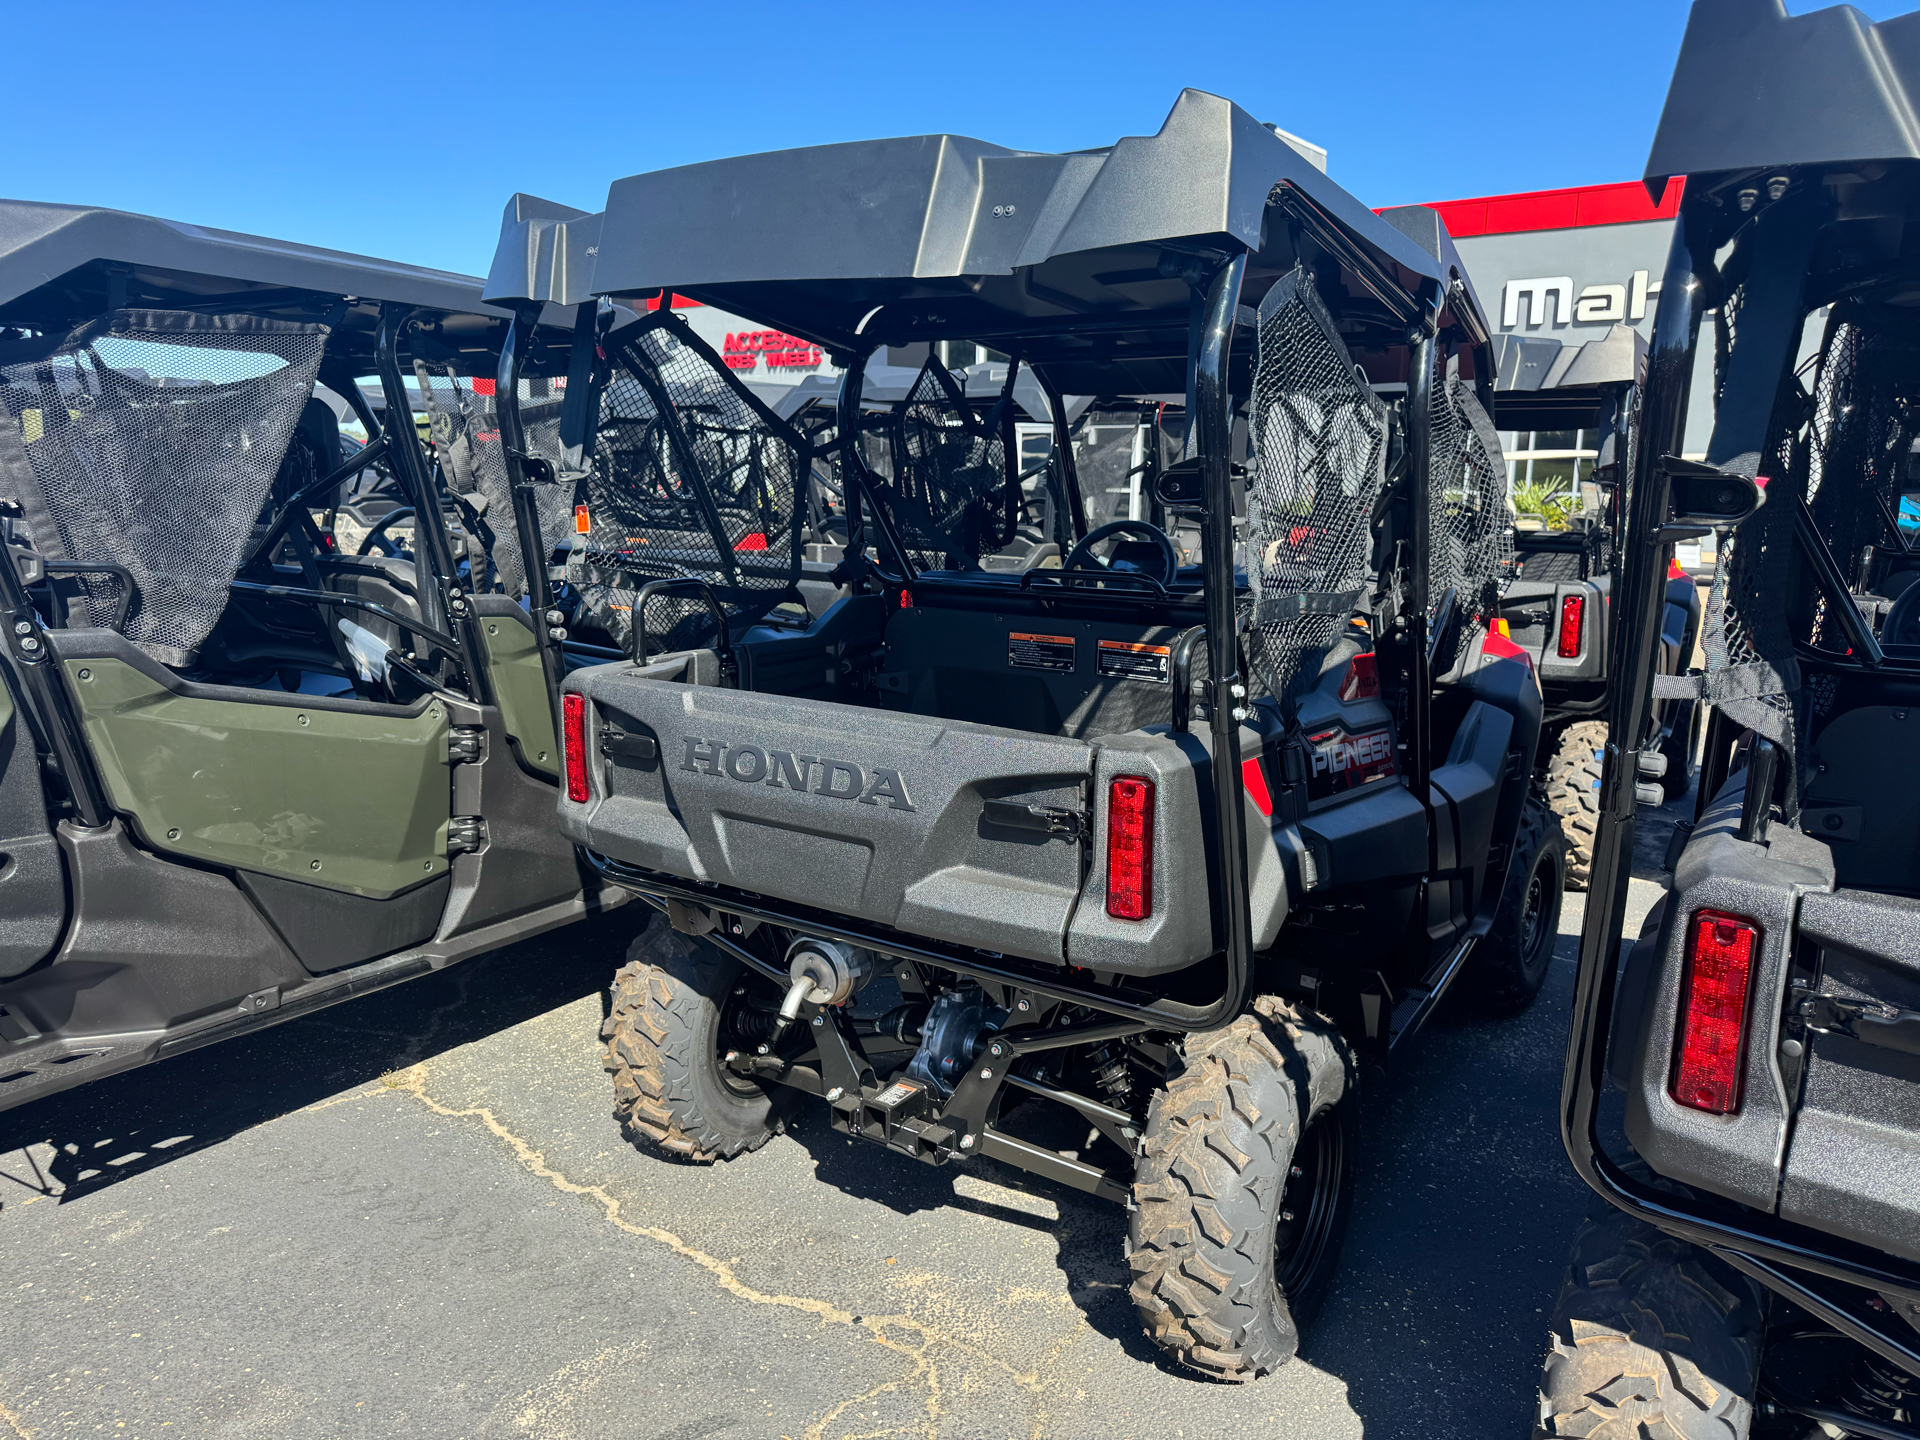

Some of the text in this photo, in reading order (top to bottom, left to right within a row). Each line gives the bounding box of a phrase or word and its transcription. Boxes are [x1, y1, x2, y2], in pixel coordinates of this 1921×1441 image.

[1503, 269, 1664, 326] Mah
[723, 330, 819, 352] ACCESSO
[765, 351, 822, 367] WHEELS
[679, 735, 916, 812] HONDA
[1311, 732, 1391, 778] PIONEER
